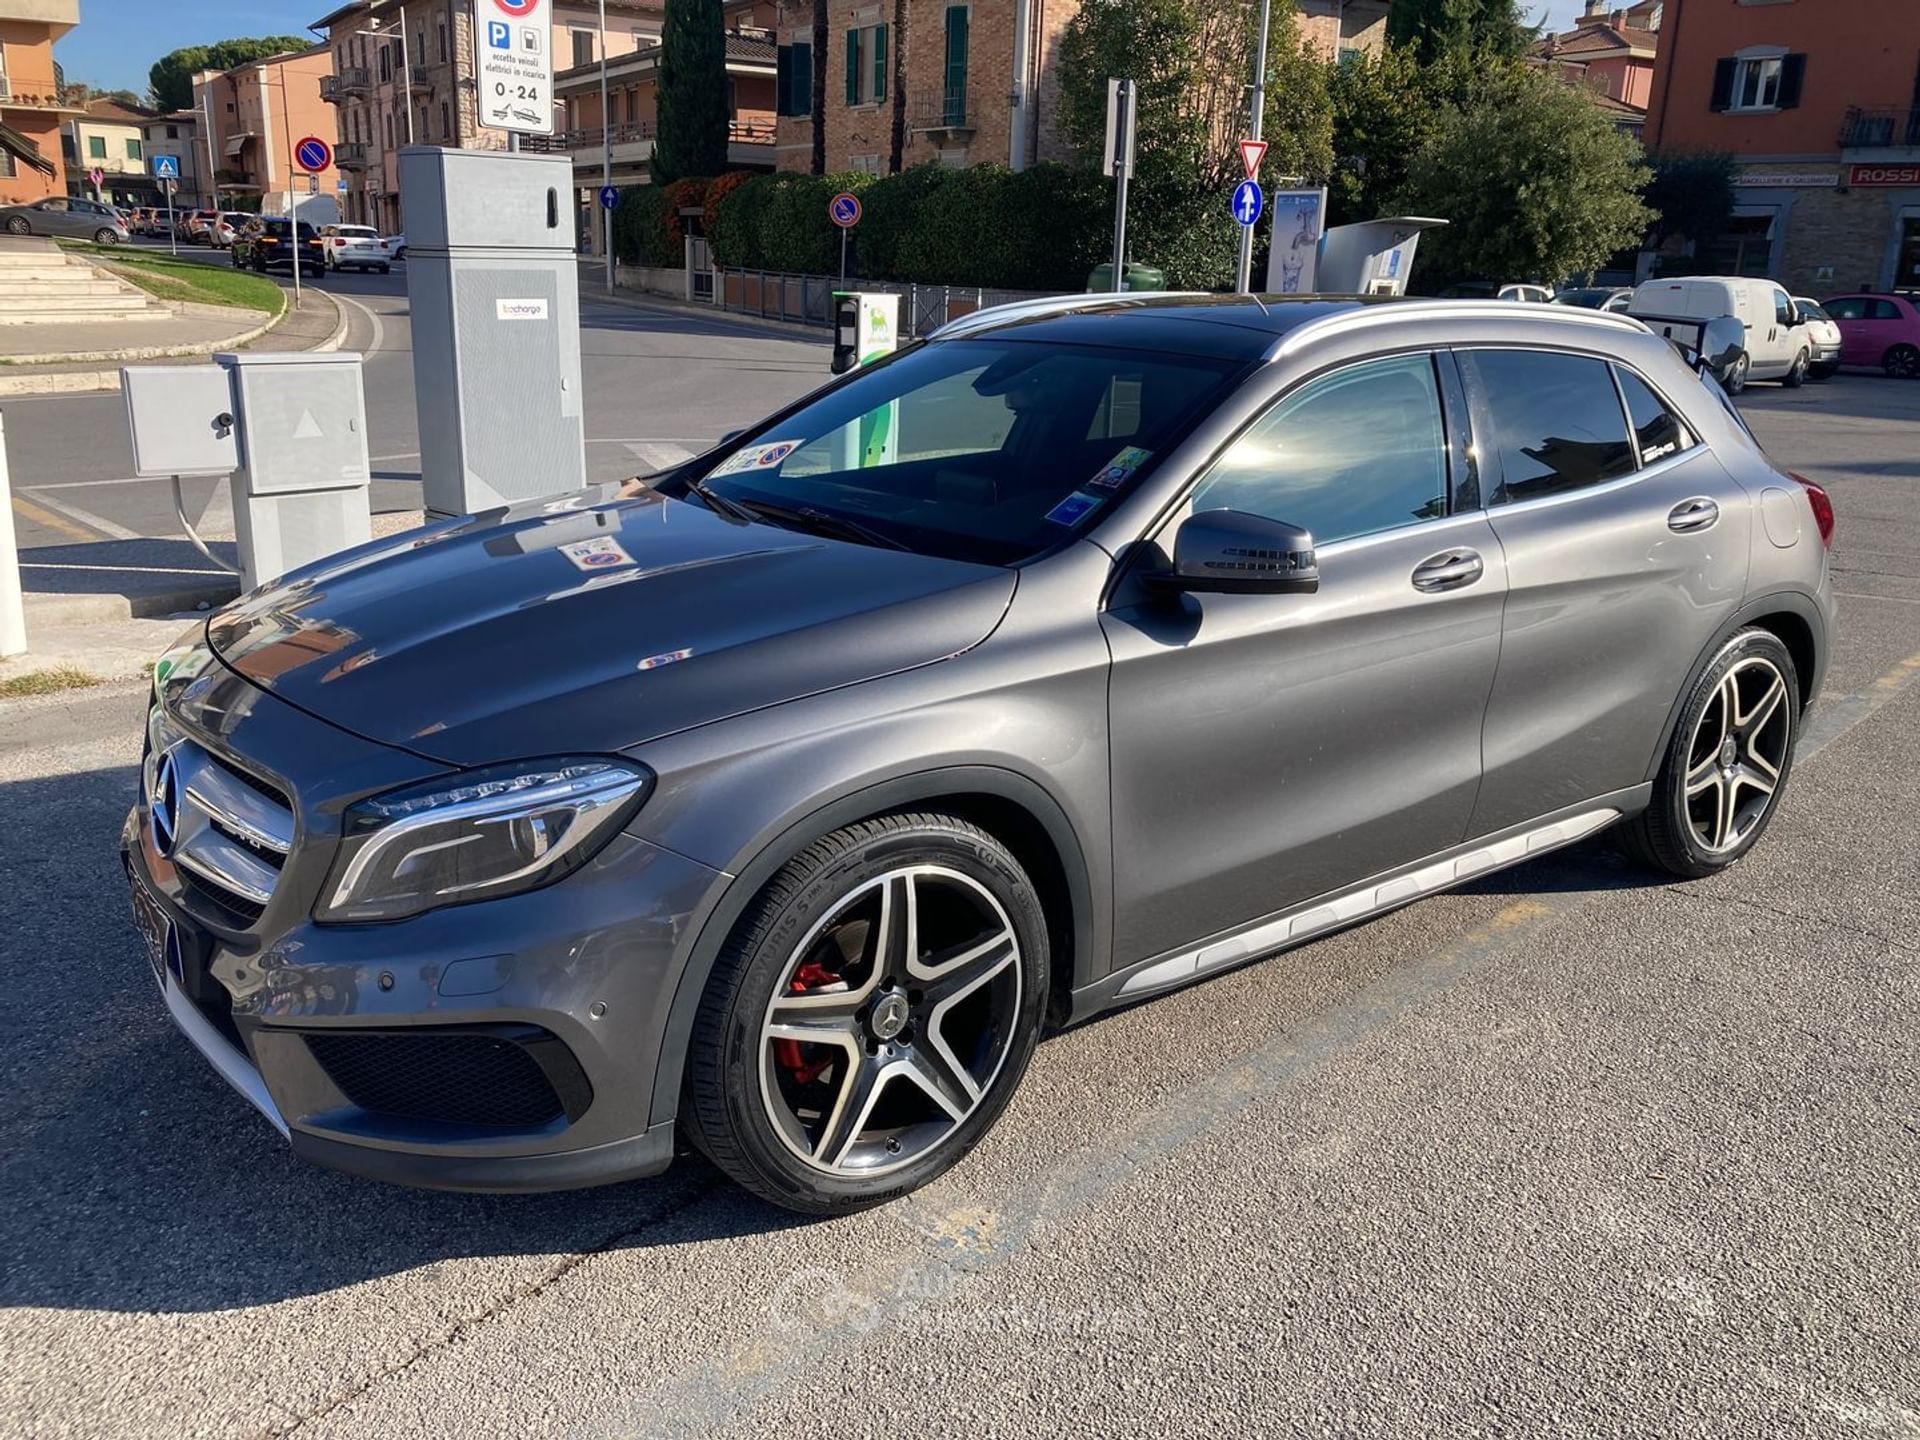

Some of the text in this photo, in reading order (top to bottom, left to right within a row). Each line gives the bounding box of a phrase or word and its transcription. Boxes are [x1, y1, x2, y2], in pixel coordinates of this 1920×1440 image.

[493, 24, 506, 46] P
[493, 53, 539, 67] eccetto veicoli
[485, 63, 512, 75] elettrici
[523, 70, 546, 80] ricarica
[495, 82, 505, 96] 0
[517, 86, 537, 101] 24
[1857, 168, 1919, 182] ROSSI
